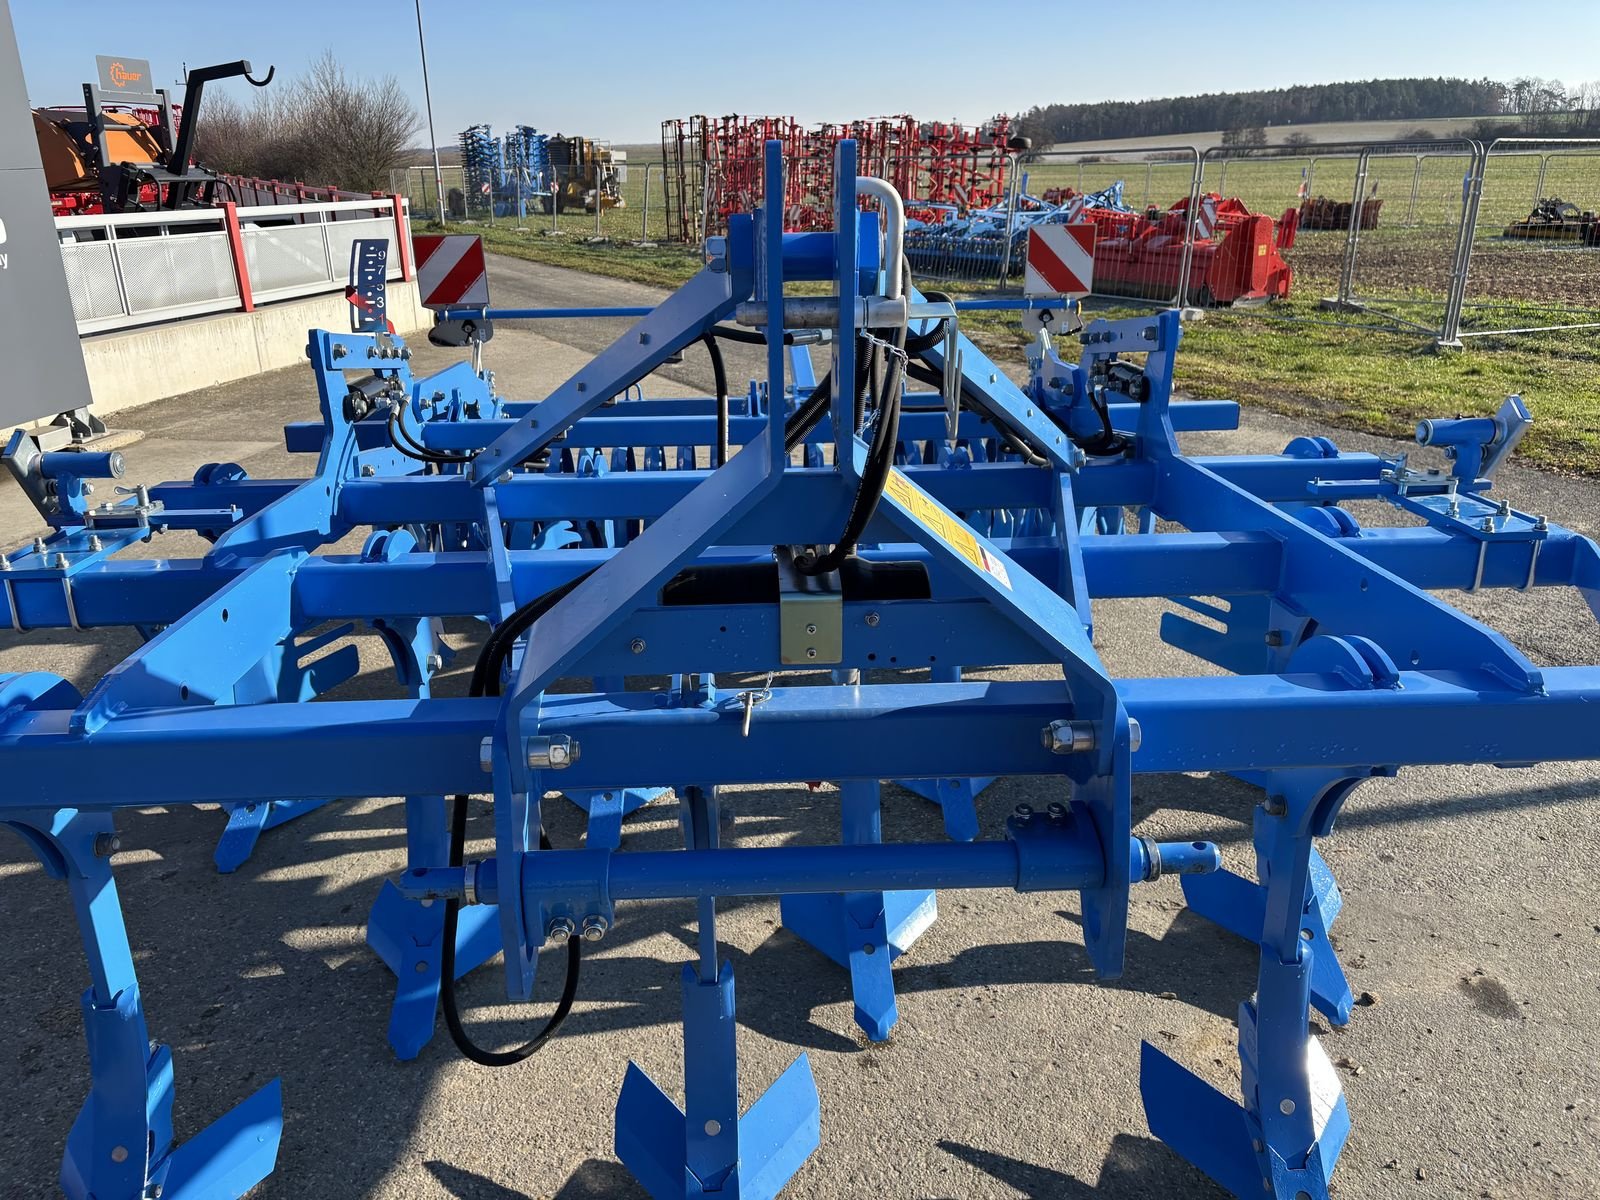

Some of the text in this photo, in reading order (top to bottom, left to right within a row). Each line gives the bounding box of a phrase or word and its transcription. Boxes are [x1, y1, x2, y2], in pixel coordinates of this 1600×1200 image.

[377, 250, 386, 260] 9
[377, 265, 385, 275] 7
[376, 296, 385, 308] 3
